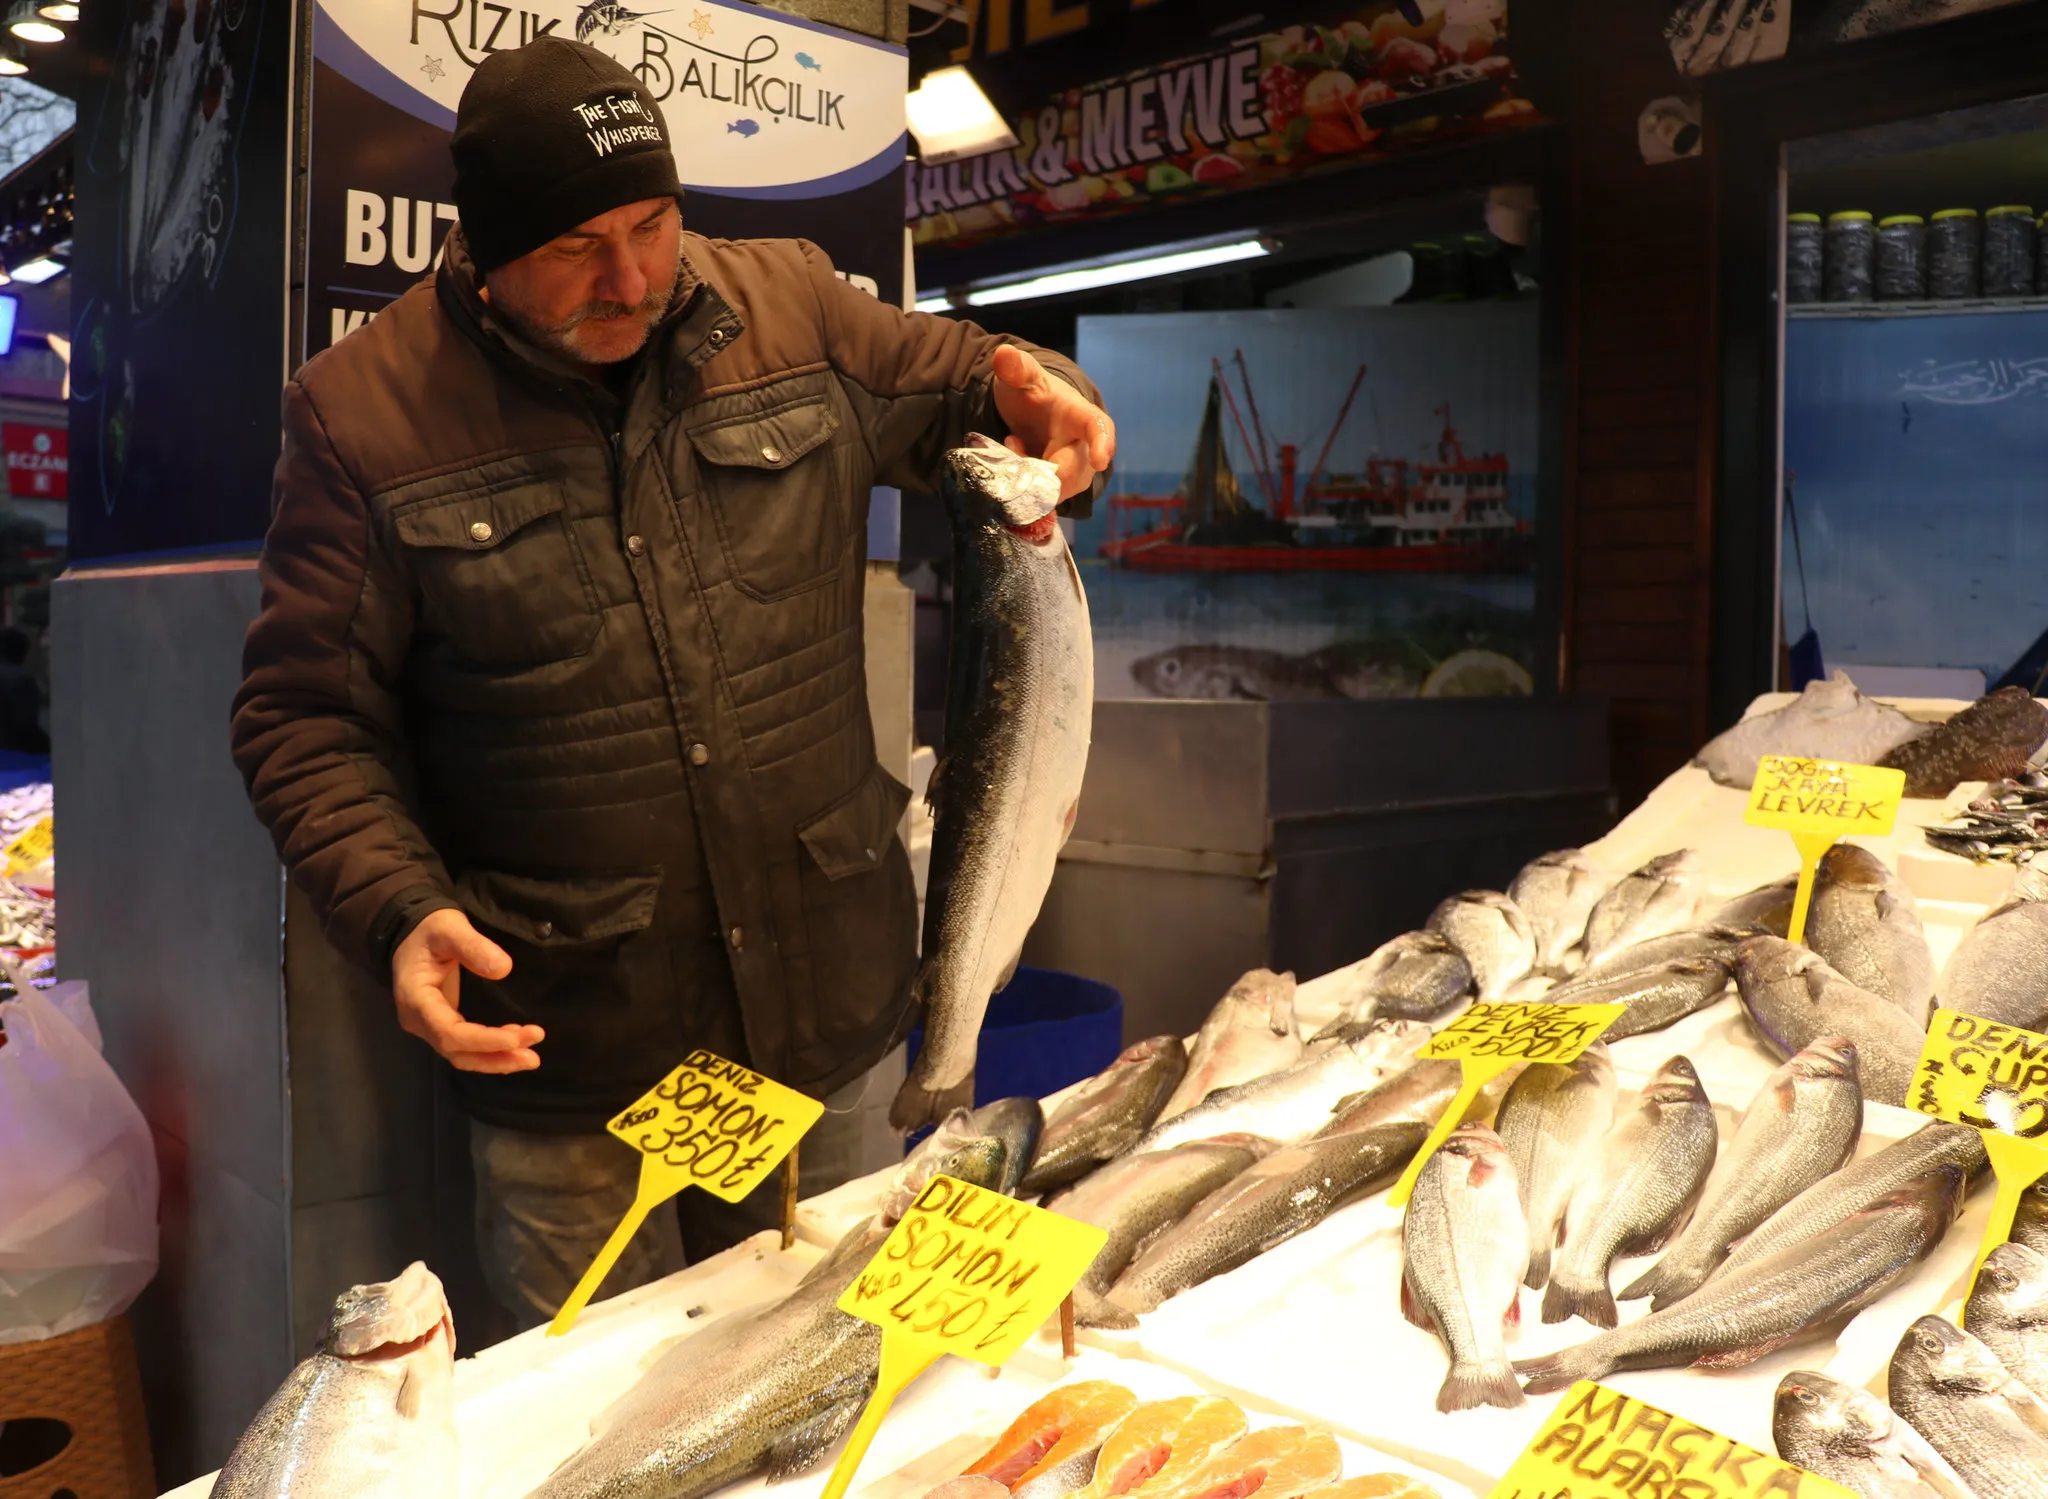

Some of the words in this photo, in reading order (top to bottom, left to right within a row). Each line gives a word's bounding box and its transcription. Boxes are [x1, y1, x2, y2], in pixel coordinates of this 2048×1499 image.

[632, 31, 846, 131] BALIKÇILIK
[572, 103, 608, 129] THE
[606, 95, 645, 121] FISH
[1030, 107, 1077, 185] &
[1081, 48, 1268, 174] MEYVE
[586, 126, 663, 157] WHISPERER
[1756, 793, 1884, 821] LEVREK
[1443, 1017, 1602, 1041] LEVREK
[1946, 1015, 2048, 1063] DEN
[1949, 1046, 2048, 1095] ÇUP
[655, 1071, 784, 1146] SOMON
[886, 1215, 1041, 1299] SOMON
